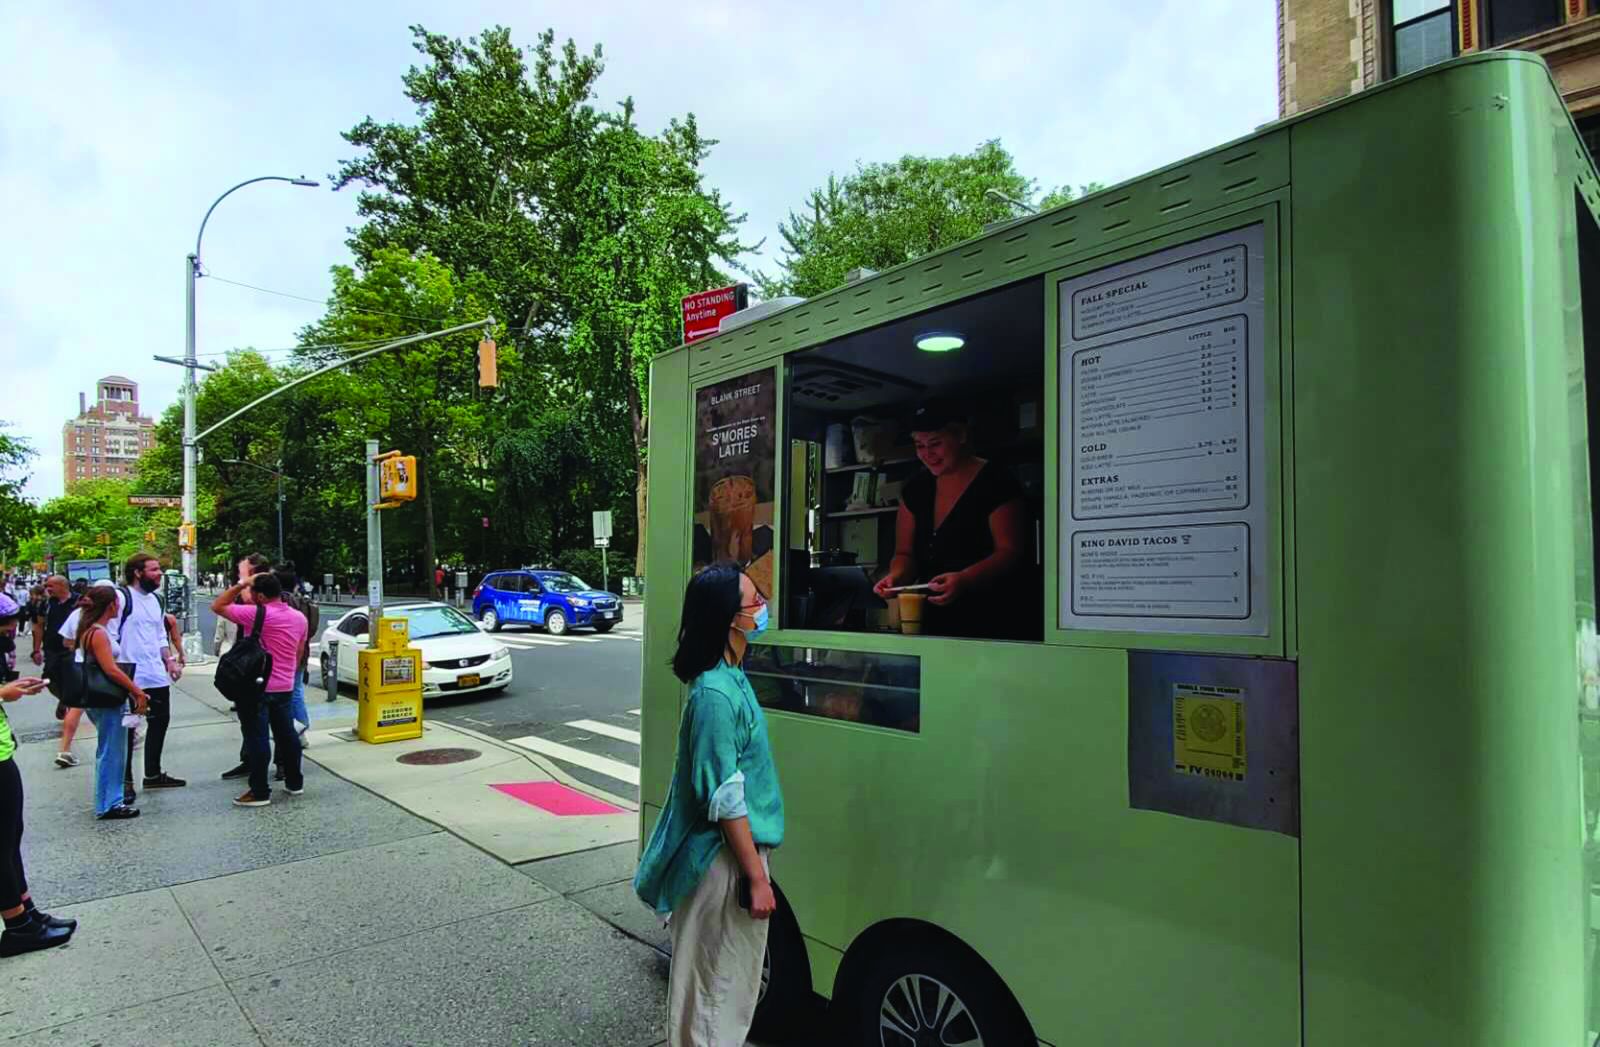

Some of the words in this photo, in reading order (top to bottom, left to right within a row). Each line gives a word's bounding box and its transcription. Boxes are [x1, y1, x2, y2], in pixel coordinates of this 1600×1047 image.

[684, 300, 696, 311] NO
[697, 291, 735, 308] STANDING
[1081, 293, 1104, 306] FALL
[1105, 281, 1149, 298] SPECIAL
[686, 309, 717, 321] Anytime
[1081, 356, 1102, 367] HOT
[711, 392, 733, 405] BLANK
[734, 384, 761, 400] STREET
[712, 425, 758, 446] S'MORES
[719, 441, 750, 459] LATTE
[1081, 443, 1107, 454] COLD
[1081, 475, 1119, 487] EXTRAS
[1081, 539, 1105, 548] KING
[1108, 538, 1140, 547] DAVID
[1143, 536, 1178, 546] TACOS
